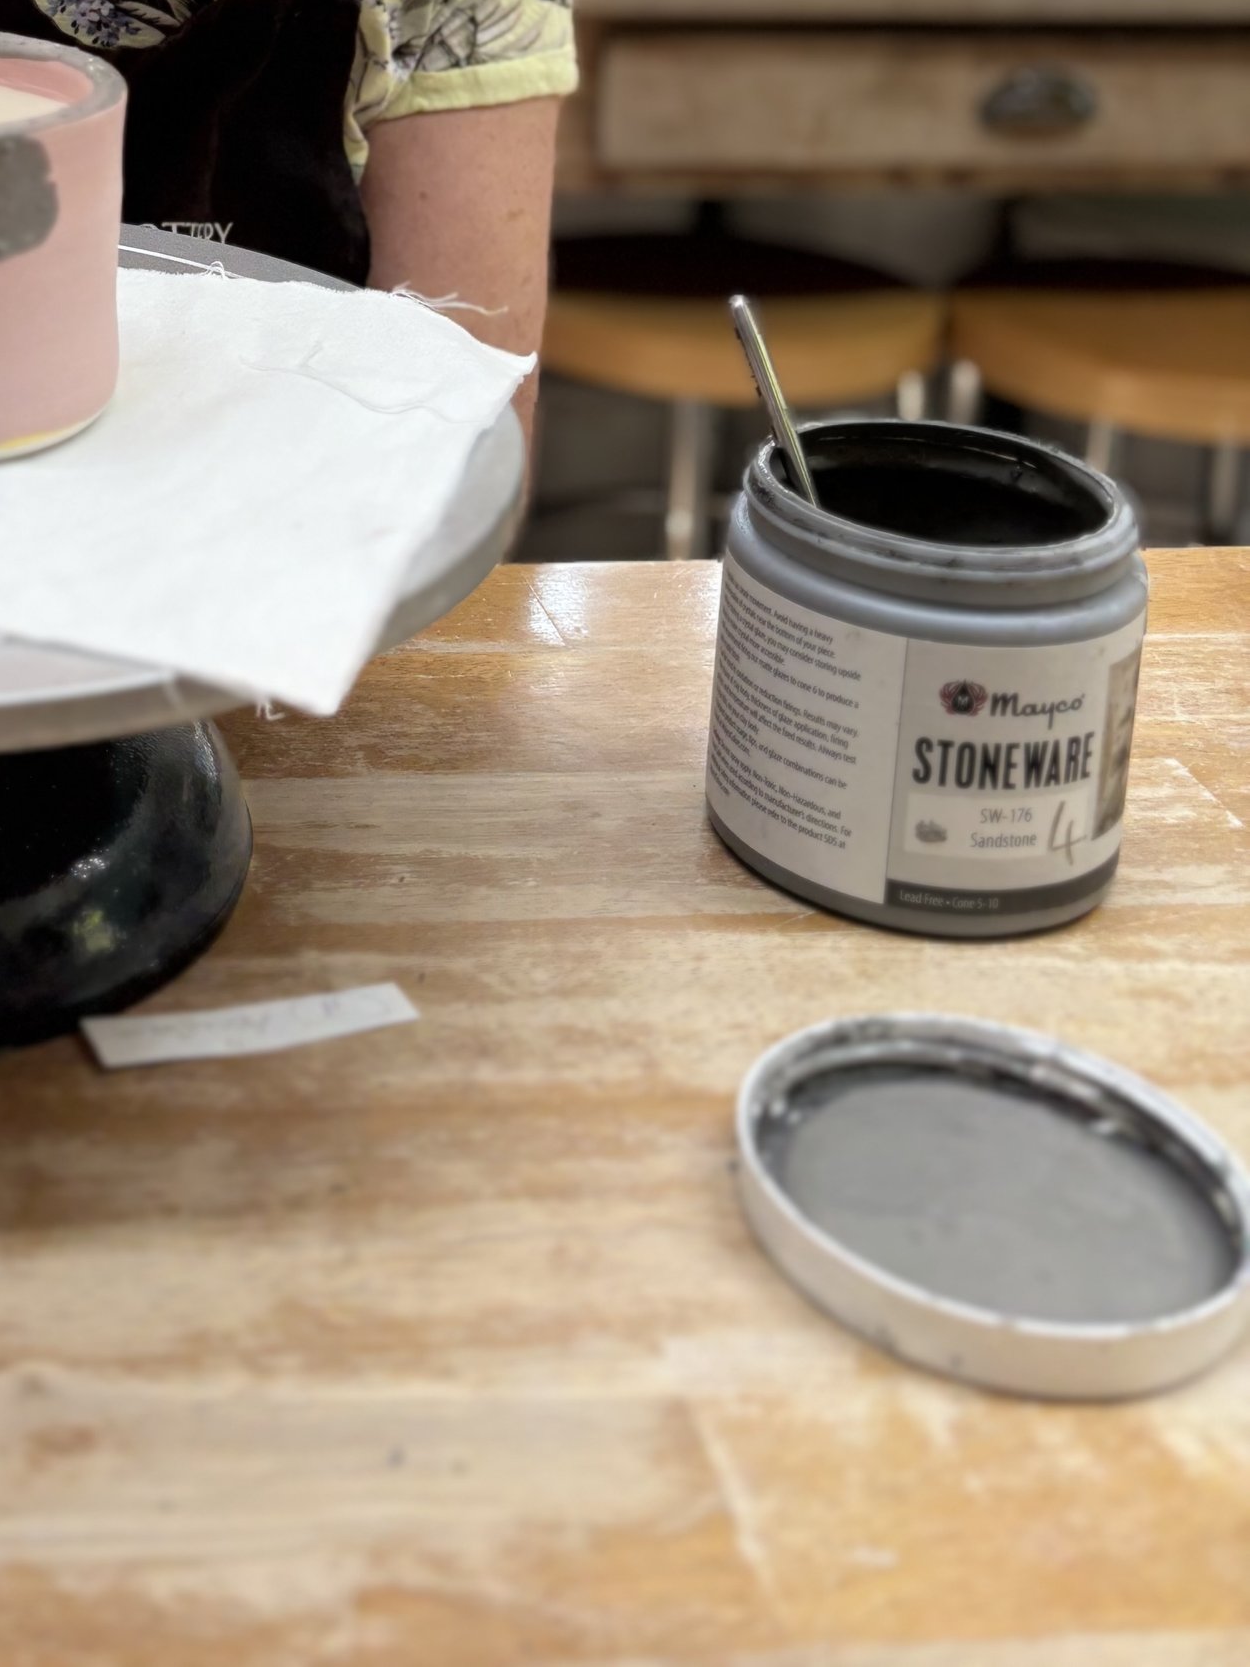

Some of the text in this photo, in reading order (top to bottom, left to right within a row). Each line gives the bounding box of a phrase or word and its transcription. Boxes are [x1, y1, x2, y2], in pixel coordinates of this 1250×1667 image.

[989, 691, 1084, 731] Mayco
[911, 731, 1096, 790] STONEWARE
[979, 807, 1033, 824] SW-176
[969, 831, 1038, 849] Sandstone
[951, 896, 975, 909] Cone
